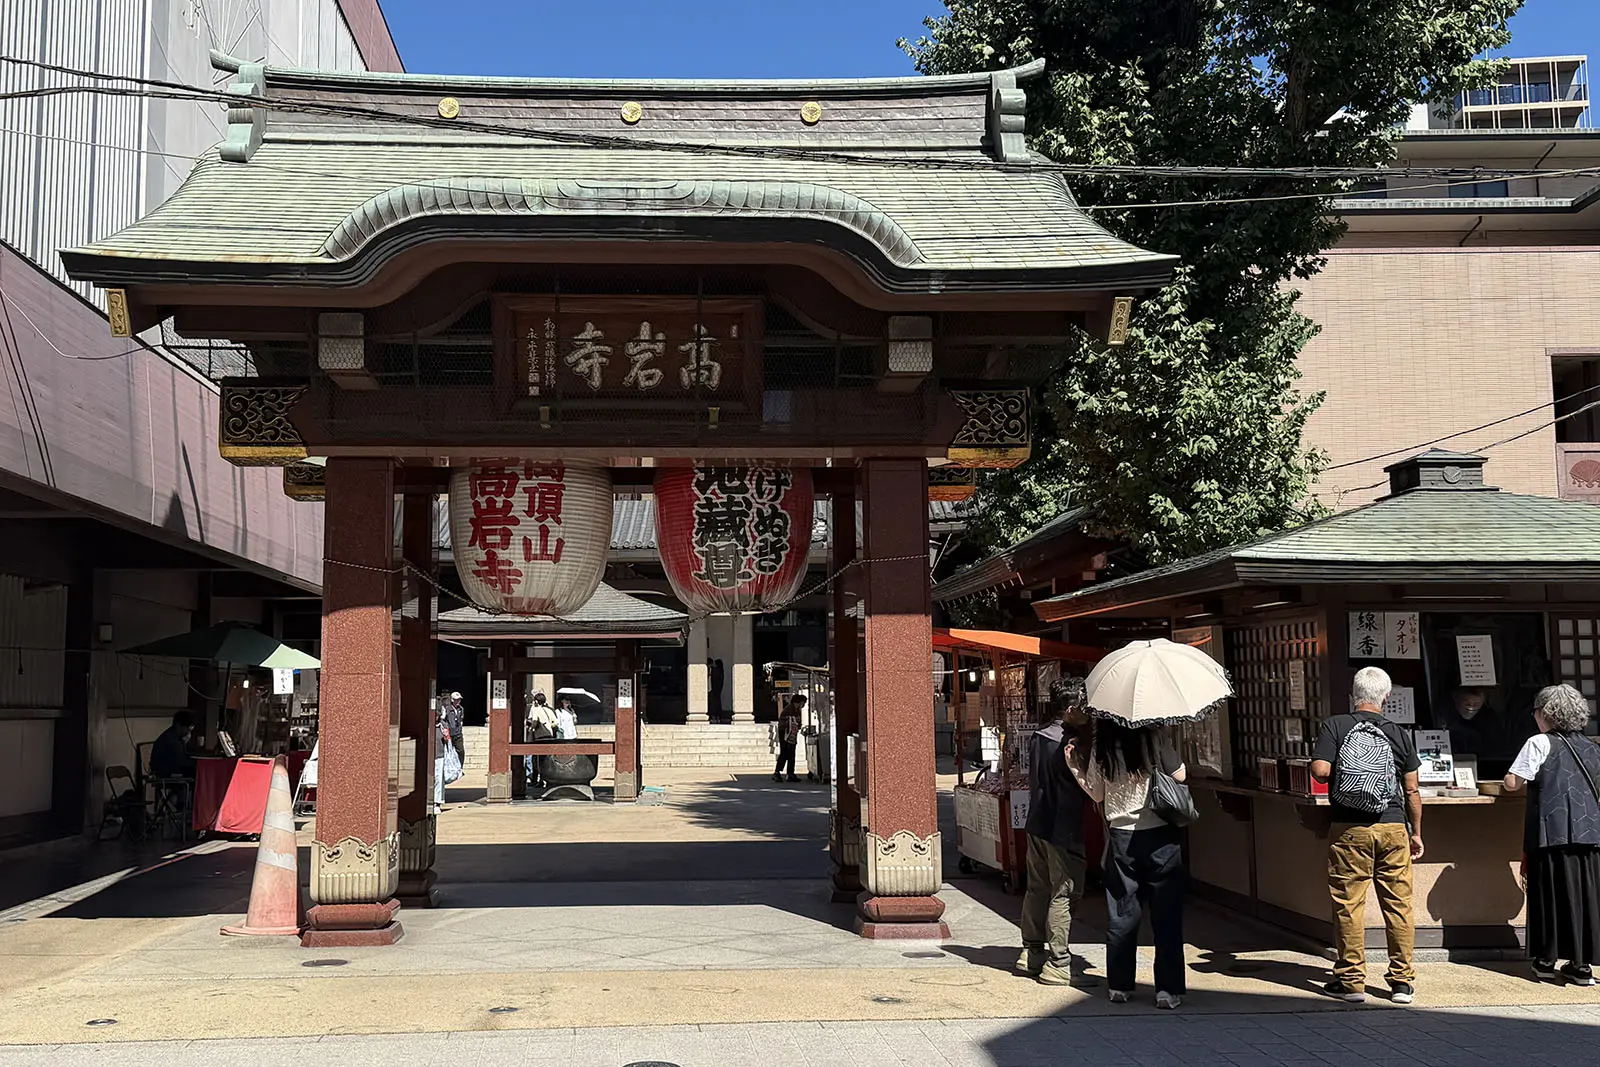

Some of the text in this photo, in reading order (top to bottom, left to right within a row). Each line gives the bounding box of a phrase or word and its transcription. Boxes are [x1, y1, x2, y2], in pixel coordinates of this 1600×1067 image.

[563, 320, 723, 391] 高岩寺
[467, 457, 523, 596] 高岩寺
[752, 460, 793, 576] げぬき
[1356, 611, 1379, 656] 線香
[1396, 619, 1409, 655] タオル
